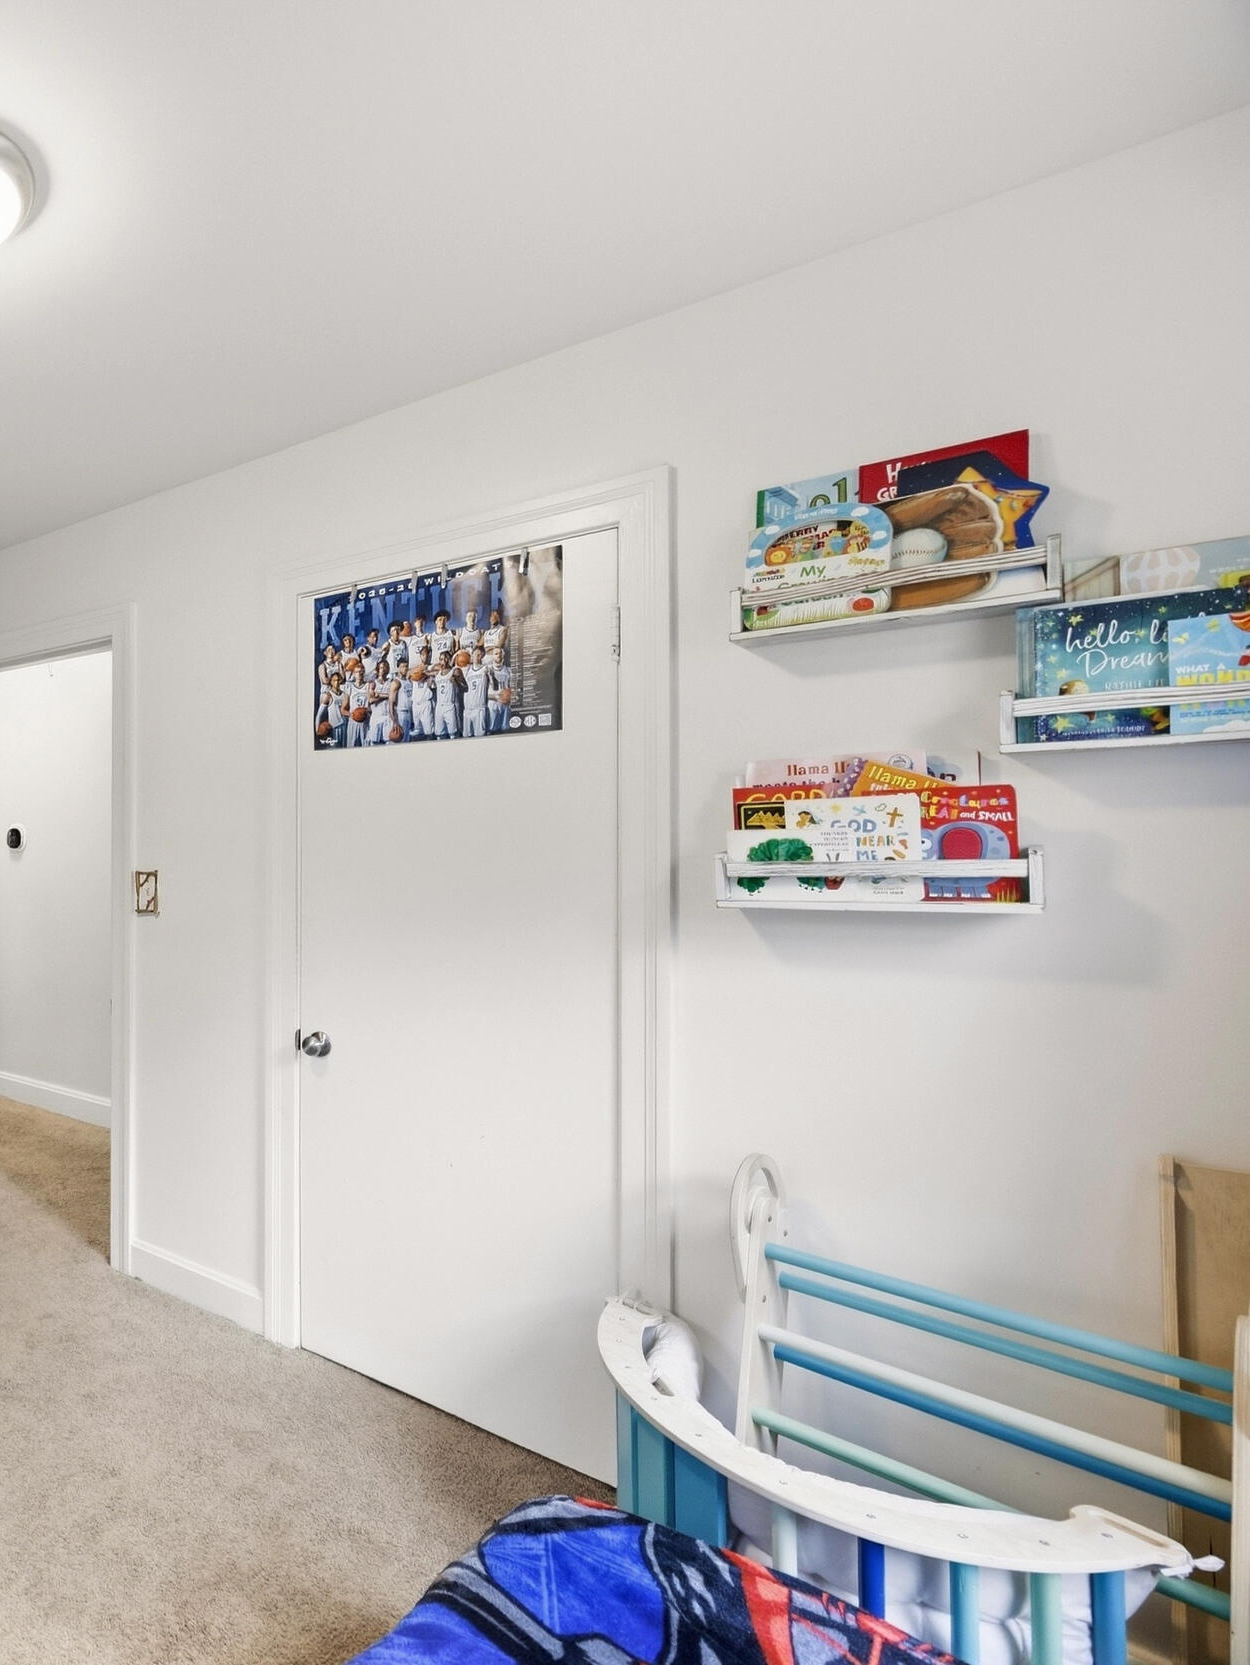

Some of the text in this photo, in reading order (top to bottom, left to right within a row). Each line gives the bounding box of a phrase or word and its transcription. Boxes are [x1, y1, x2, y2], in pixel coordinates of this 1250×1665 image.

[424, 562, 501, 587] WIDCAT
[800, 565, 827, 578] My
[318, 572, 507, 650] KENTUCK
[1175, 663, 1210, 675] WHAT
[787, 764, 829, 776] llama
[868, 765, 917, 790] llama
[920, 790, 1010, 809] Creatures
[920, 805, 1015, 822] REAT and SMALL
[856, 835, 896, 847] NEAR
[856, 850, 879, 861] ME
